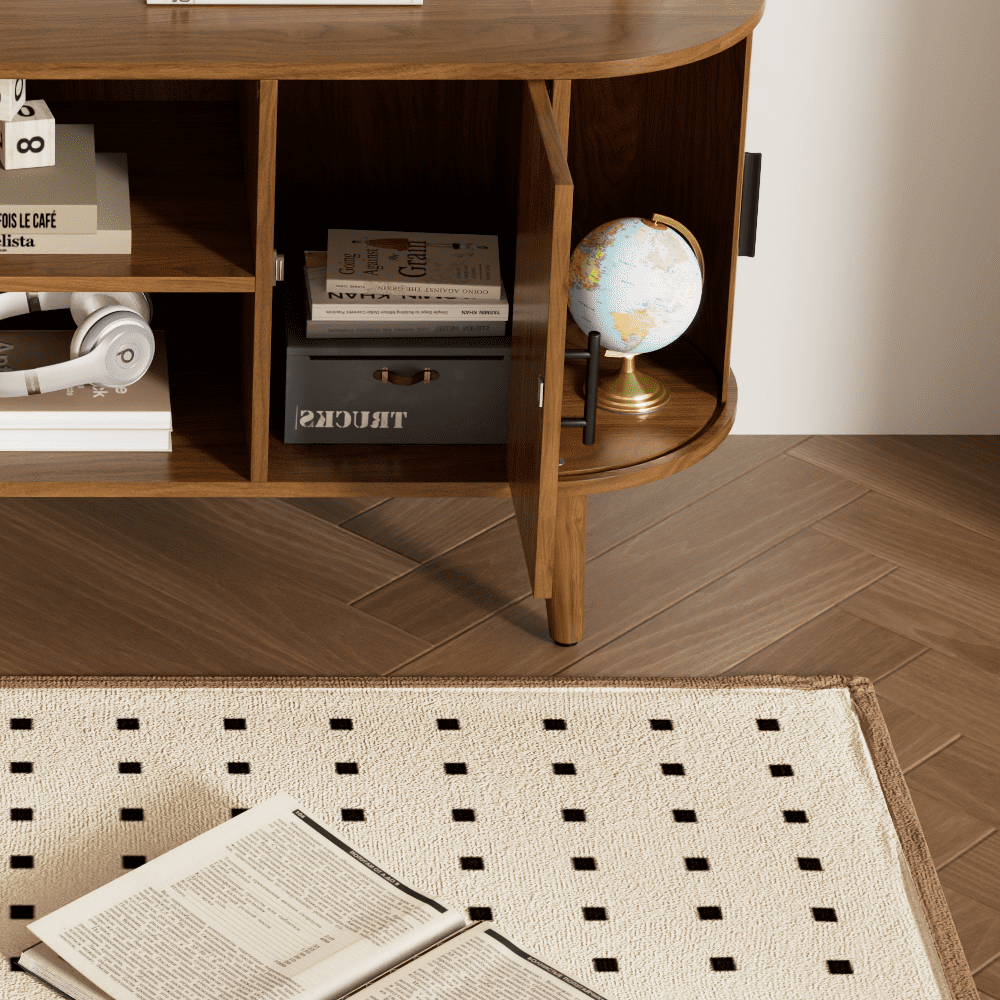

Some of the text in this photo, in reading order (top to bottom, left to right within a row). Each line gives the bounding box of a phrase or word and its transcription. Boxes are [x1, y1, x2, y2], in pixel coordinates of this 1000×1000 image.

[16, 135, 45, 154] 8
[19, 212, 30, 228] LE
[33, 208, 57, 228] CAFÉ
[338, 253, 361, 276] Going
[362, 248, 384, 276] Against
[398, 240, 427, 278] Grain
[376, 284, 401, 292] GRAIN
[425, 287, 460, 295] AGAINST
